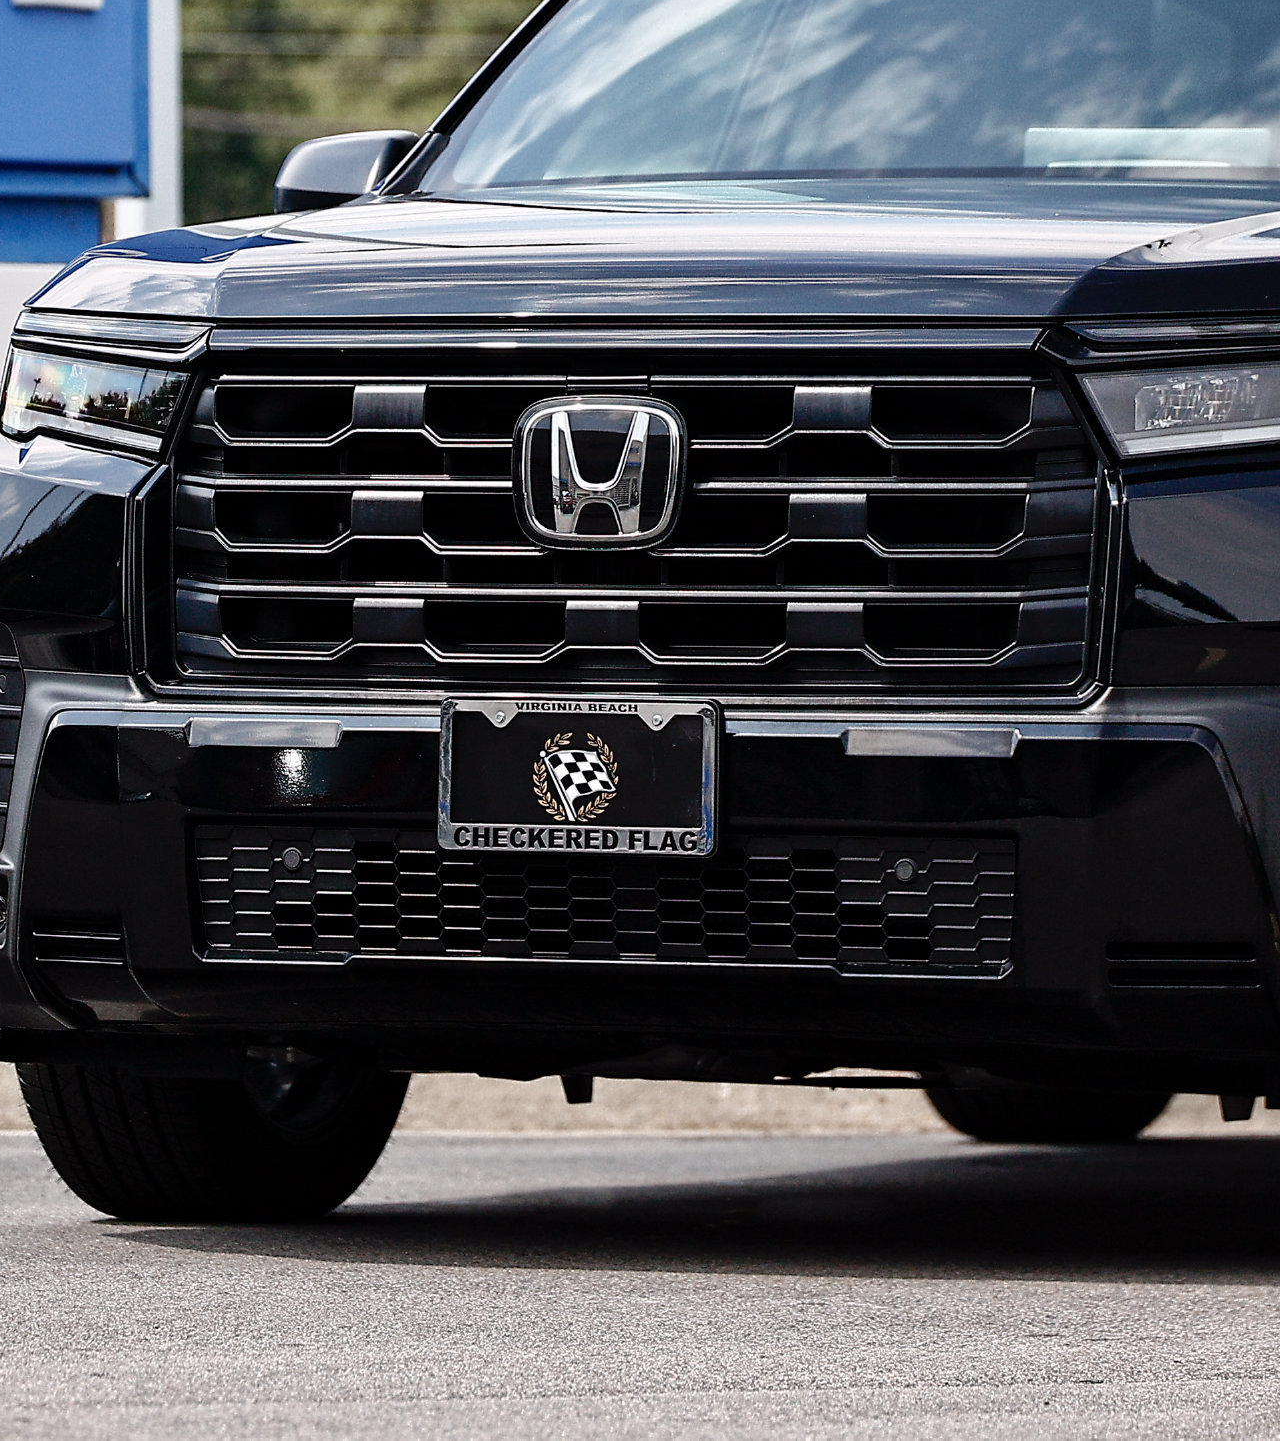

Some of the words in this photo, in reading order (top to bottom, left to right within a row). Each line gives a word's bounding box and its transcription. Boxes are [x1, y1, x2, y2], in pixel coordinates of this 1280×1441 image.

[515, 701, 583, 712] VIRGINIA
[588, 703, 639, 714] BEACH
[453, 825, 619, 851] CHECKERED
[628, 830, 698, 853] FLAG
